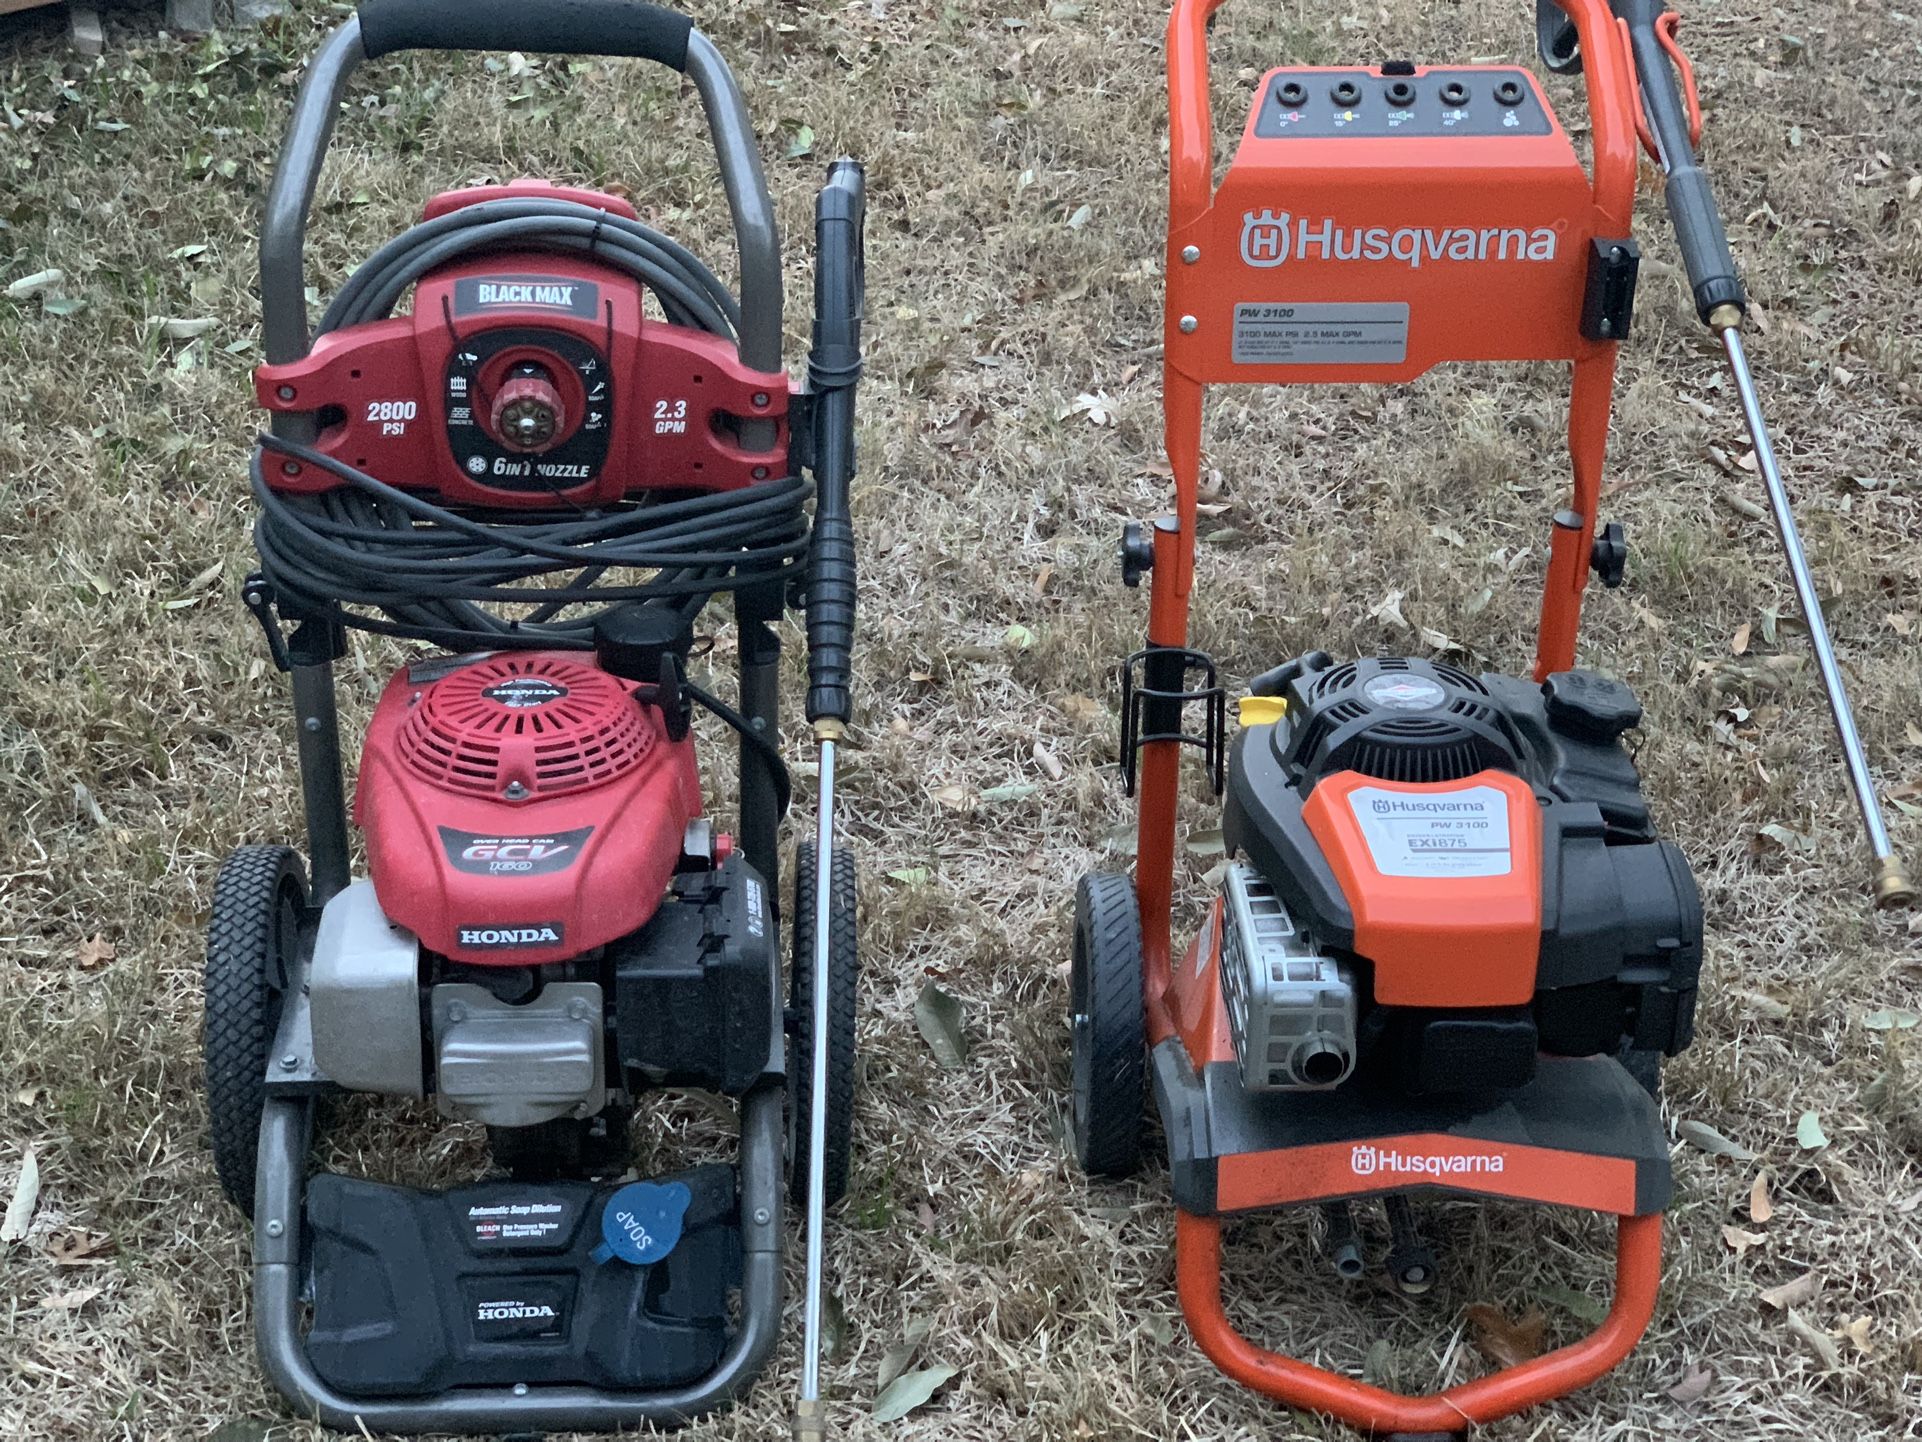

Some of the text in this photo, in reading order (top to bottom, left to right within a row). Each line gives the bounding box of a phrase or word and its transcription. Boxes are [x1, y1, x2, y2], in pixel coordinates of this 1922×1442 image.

[1297, 217, 1556, 268] Husqvarna
[478, 283, 573, 306] BLACK MAX
[1239, 308, 1295, 318] PW 3100
[1238, 330, 1261, 338] 3100
[1263, 330, 1283, 338] MAX
[1285, 330, 1299, 338] PSI
[1320, 330, 1340, 338] MAX
[1342, 330, 1362, 338] GPM
[366, 401, 417, 421] 2800
[653, 400, 687, 419] 2.3
[382, 422, 405, 436] PSI
[655, 421, 686, 434] GPM
[1391, 801, 1485, 813] Husqvarna
[1430, 821, 1489, 829] PW 3100
[462, 844, 570, 860] GCV
[489, 861, 533, 871] 160
[460, 928, 560, 944] HONDA
[1378, 1150, 1504, 1177] Husqvarna
[468, 1204, 562, 1216] Automatic Soap Dilution
[476, 1224, 501, 1233] BLEACH
[616, 1211, 652, 1250] SOAP
[477, 1306, 555, 1320] HONDA
